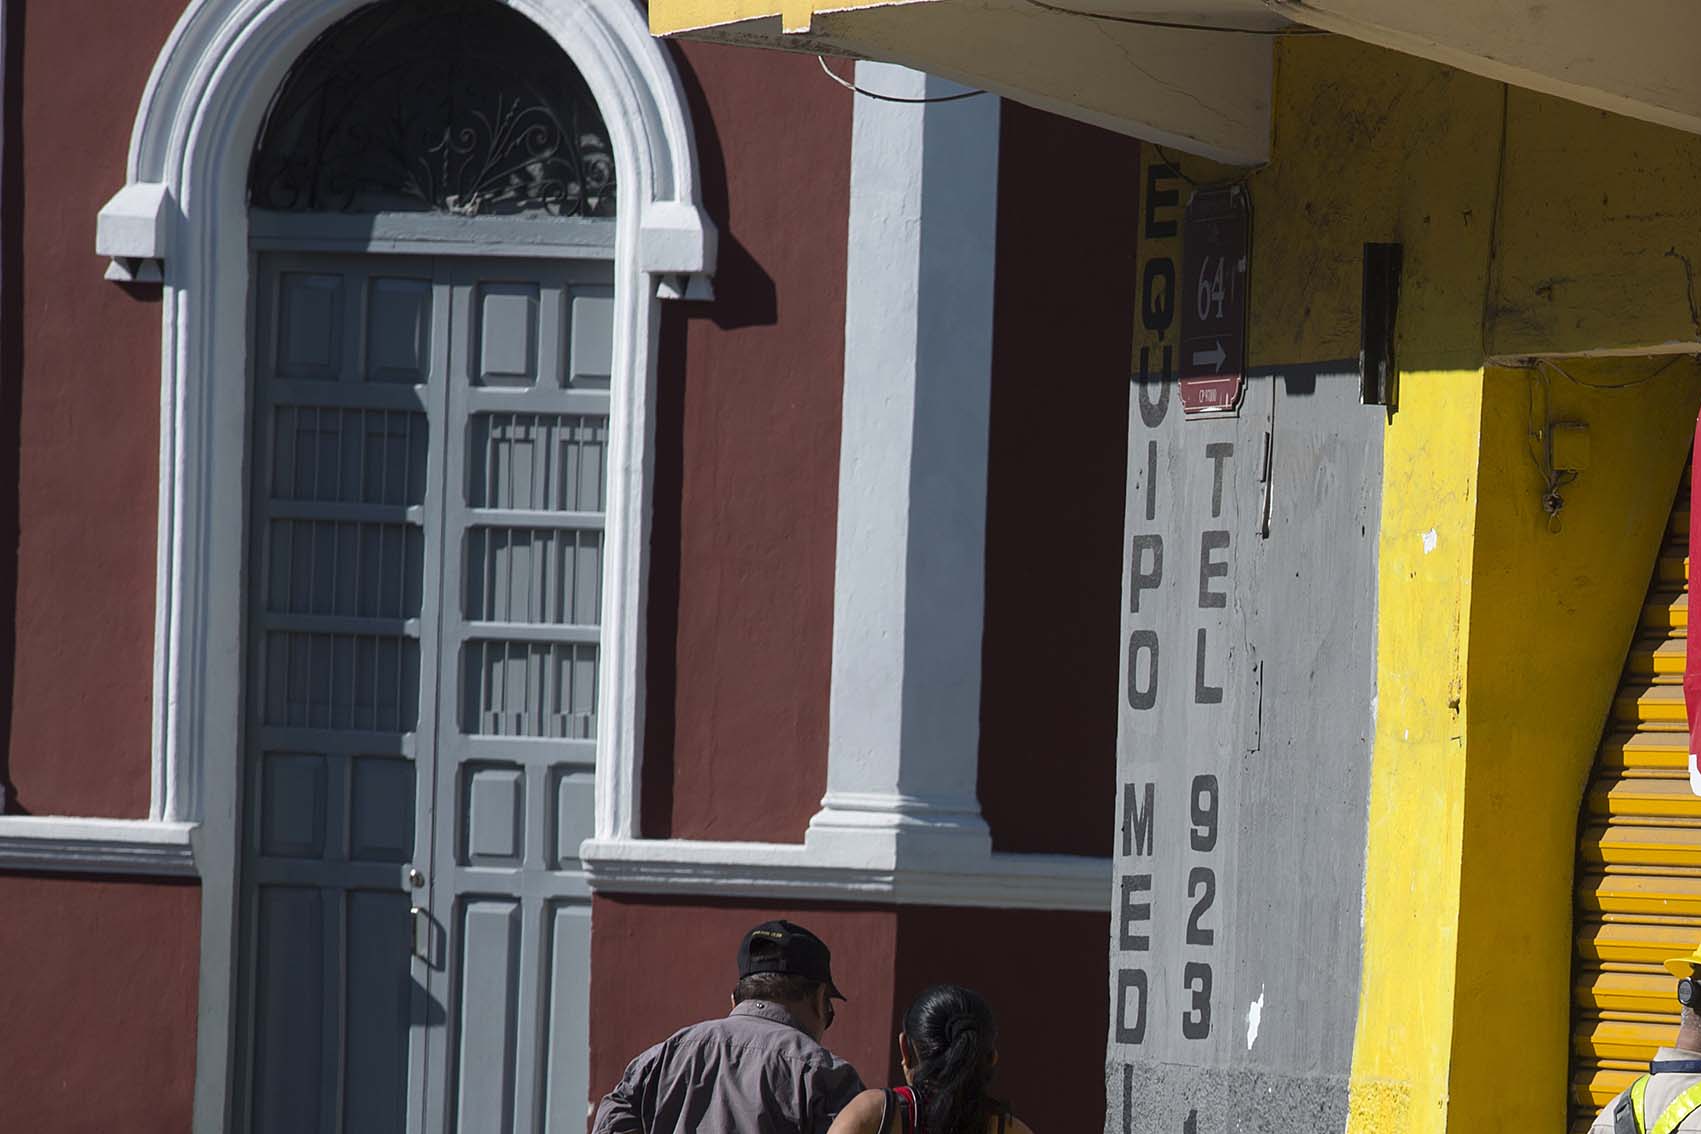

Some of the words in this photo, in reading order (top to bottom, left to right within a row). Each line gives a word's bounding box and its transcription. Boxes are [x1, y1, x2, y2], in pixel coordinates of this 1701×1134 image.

[1197, 255, 1225, 321] 64
[1127, 163, 1180, 710] EQUIPO
[1194, 442, 1234, 704] TEL
[1183, 774, 1219, 1040] 923
